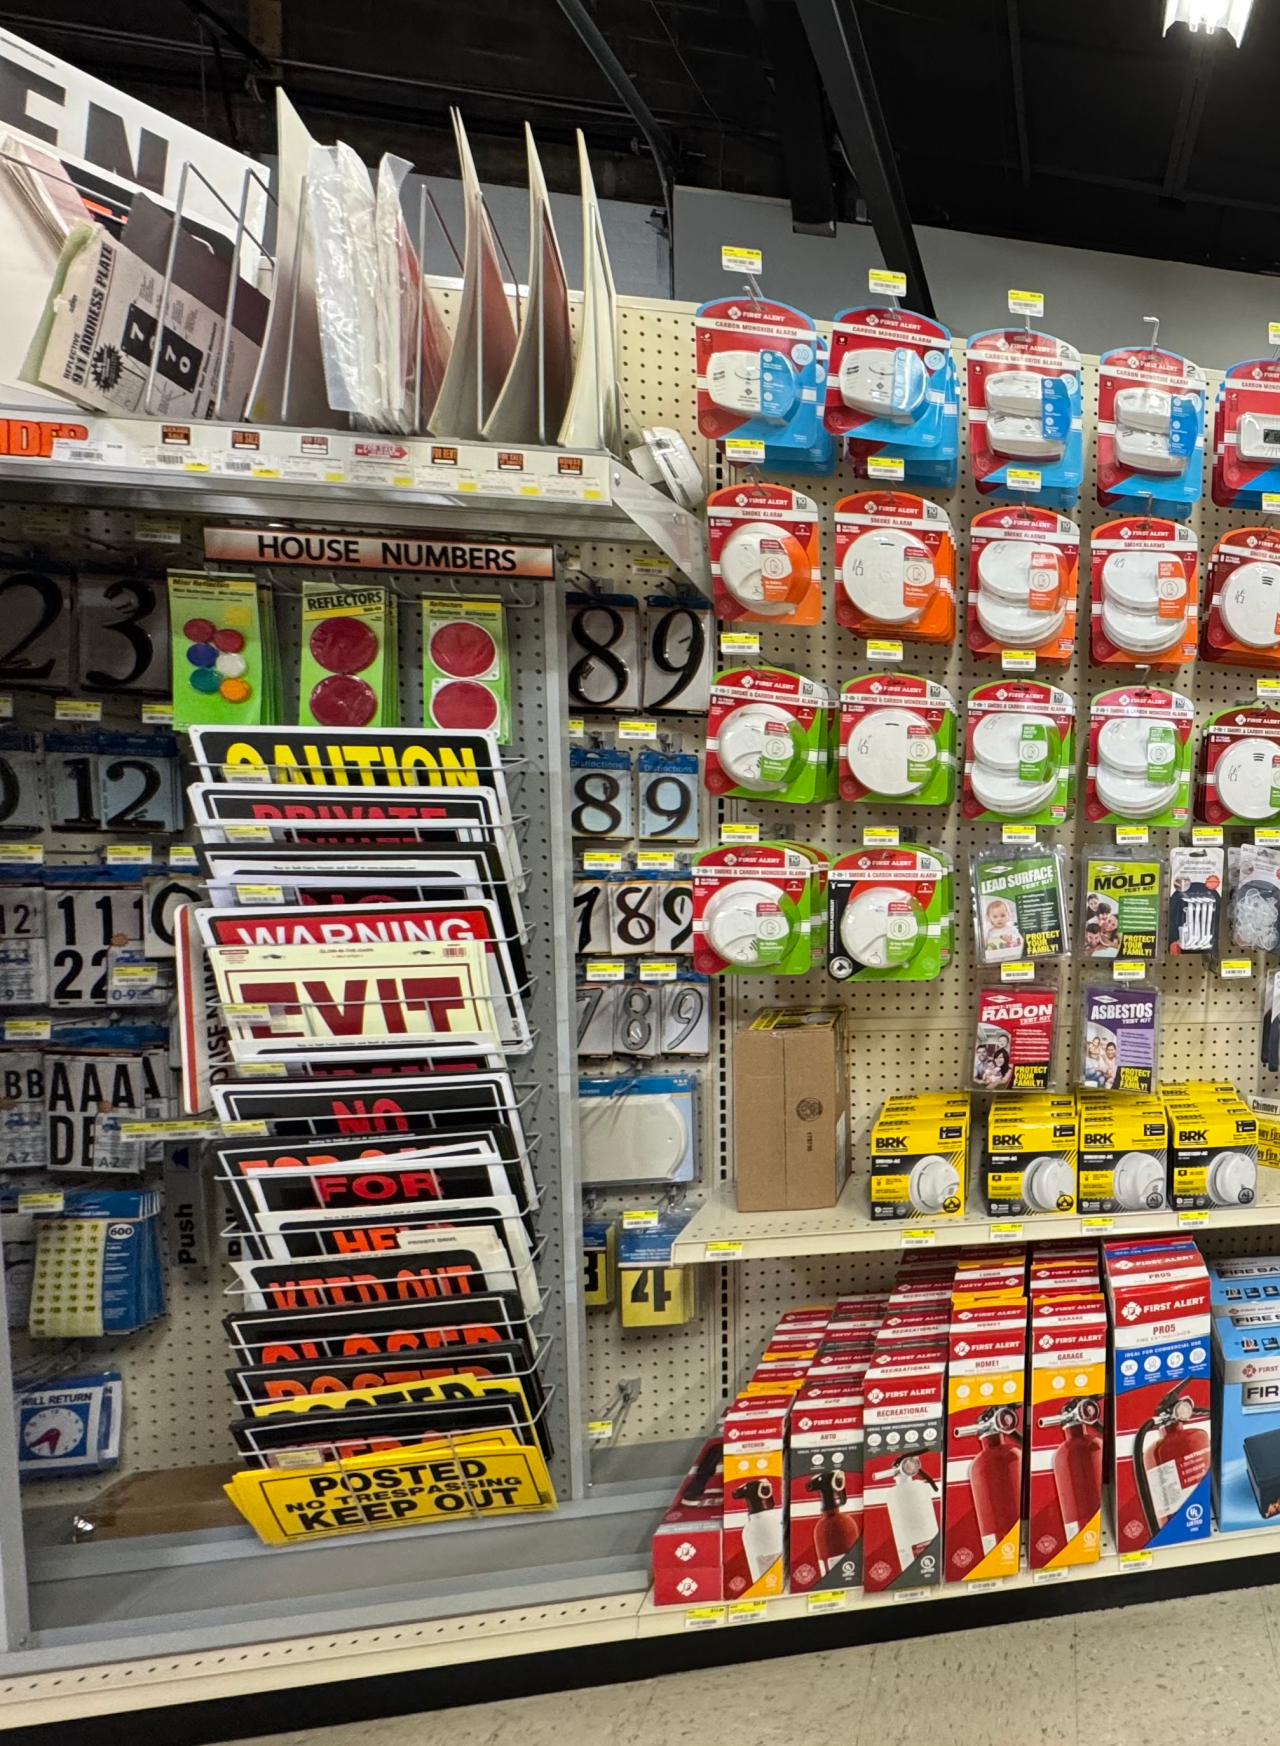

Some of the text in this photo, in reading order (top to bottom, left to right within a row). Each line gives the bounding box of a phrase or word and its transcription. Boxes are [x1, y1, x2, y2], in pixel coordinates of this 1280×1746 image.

[71, 242, 113, 386] 911 ADDRESS PLATE
[763, 314, 785, 322] ALERT
[715, 321, 797, 337] CARBON MONOXIDE ALARM
[853, 327, 932, 344] CARBON MONOXIDE ALARM
[1024, 532, 1046, 540] ALARMS
[257, 535, 516, 572] HOUSE NUMBERS
[308, 592, 383, 610] REFLECTORS
[568, 605, 629, 706] 8
[644, 608, 705, 707] 9
[226, 742, 480, 786] CAUTION
[570, 758, 623, 769] Distinctions
[643, 763, 693, 773] Distinctions
[106, 760, 166, 830] 2
[572, 773, 622, 835] 8
[646, 776, 691, 837] 9
[981, 866, 1054, 894] LEAD SURFACE
[1021, 878, 1054, 890] TEST KIT
[1093, 873, 1156, 891] MOLD
[236, 918, 474, 945] WARNING
[1025, 930, 1060, 941] PROTECT
[1027, 939, 1047, 947] YOUR
[1123, 935, 1155, 944] PROTECT
[1027, 944, 1059, 955] FAMILY!
[1123, 948, 1152, 956] FAMILY!
[981, 1004, 1053, 1022] RADON
[1091, 1003, 1153, 1020] ASBESTOS
[1014, 1066, 1047, 1075] PROTECT
[1120, 1067, 1151, 1077] PROTECT
[1013, 1079, 1044, 1087] FAMILY!
[1120, 1074, 1139, 1082] YOUR
[1120, 1081, 1148, 1089] FAMILY!
[1252, 1099, 1278, 1112] Chimney
[332, 1098, 409, 1133] NO
[876, 1136, 907, 1148] BRK
[992, 1134, 1022, 1146] BRK
[1084, 1133, 1115, 1145] BRK
[1179, 1130, 1207, 1142] BRK
[1266, 1148, 1277, 1160] Fire
[316, 1173, 445, 1202] FOR
[110, 1225, 133, 1237] 600
[1144, 1296, 1205, 1313] FIRST ALERT
[1235, 1313, 1267, 1324] FIRE
[1153, 1324, 1176, 1335] PRO5
[971, 1340, 1021, 1351] FIRST ALERT
[1053, 1334, 1102, 1345] FIRST ALERT
[1155, 1344, 1189, 1353] COMMERCIAL
[1057, 1352, 1084, 1361] GARAGE
[975, 1360, 1000, 1369] HOME1
[1258, 1364, 1280, 1373] FIRST
[22, 1392, 92, 1406] WILL RETURN
[885, 1387, 936, 1399] FIRST ALERT
[877, 1406, 929, 1418] RECREATIONAL
[814, 1417, 857, 1427] FIRST ALERT
[820, 1433, 837, 1441] AUTO
[742, 1441, 765, 1449] KITCHEN
[309, 1459, 488, 1499] POSTED
[285, 1477, 523, 1513] NO TRESPASSING
[298, 1487, 519, 1531] KEEP OUT
